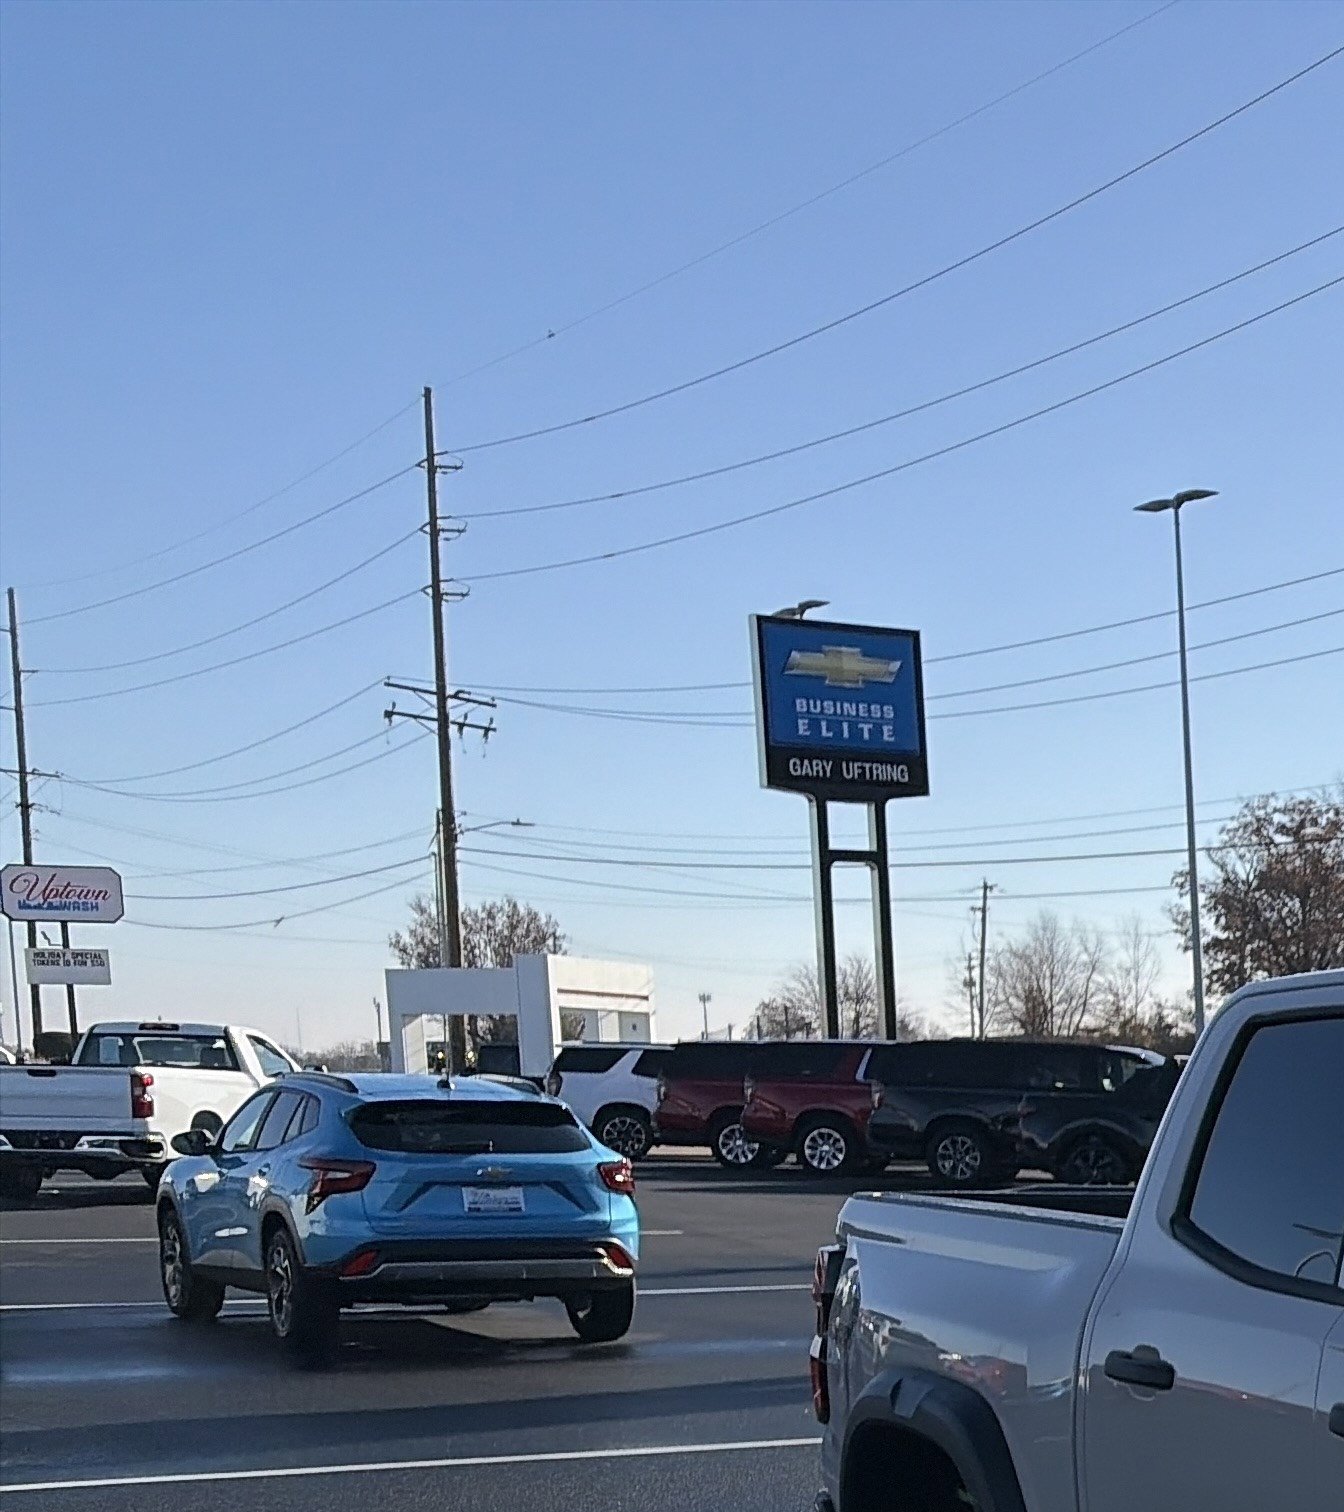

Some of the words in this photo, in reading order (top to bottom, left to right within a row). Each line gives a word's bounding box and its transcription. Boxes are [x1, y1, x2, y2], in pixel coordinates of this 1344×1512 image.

[795, 698, 894, 719] BUSINESS
[797, 719, 895, 742] ELITE
[789, 758, 833, 778] GARY
[842, 761, 909, 783] UFTRING
[9, 872, 111, 906] Uptown
[61, 901, 99, 912] WASH
